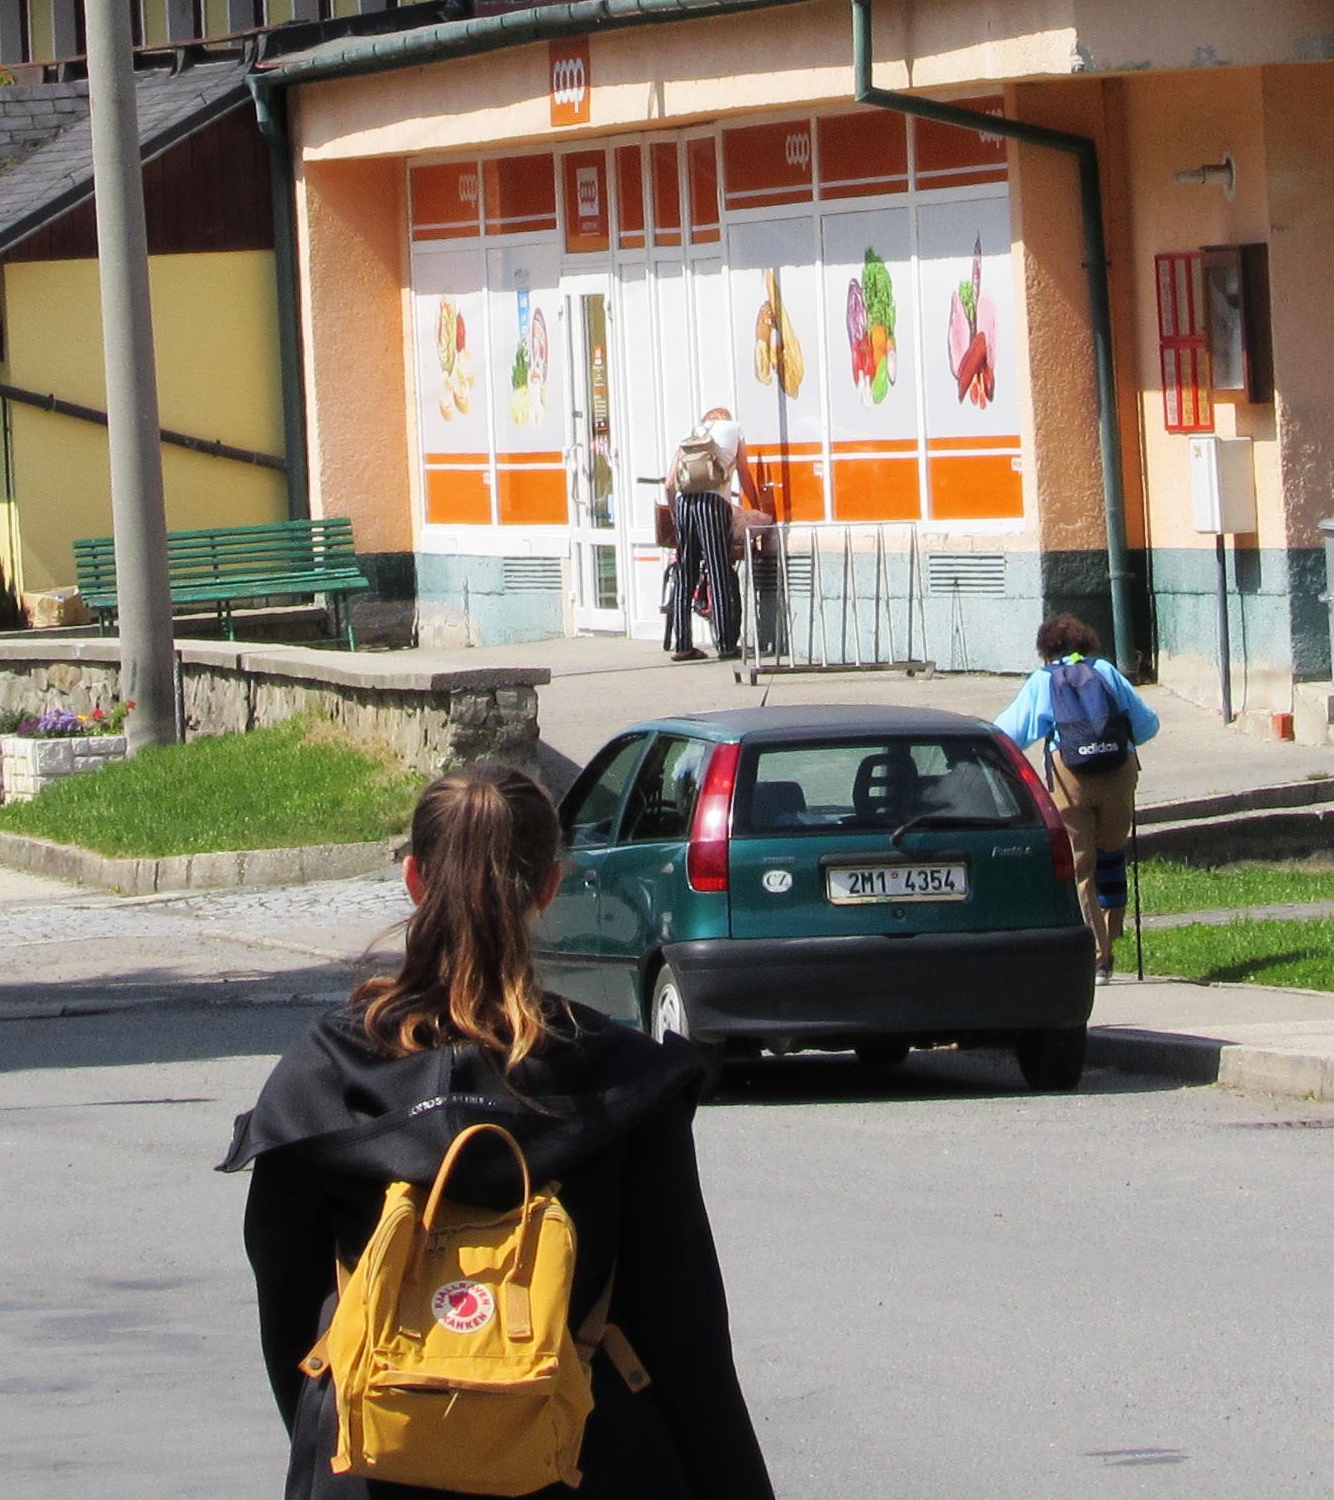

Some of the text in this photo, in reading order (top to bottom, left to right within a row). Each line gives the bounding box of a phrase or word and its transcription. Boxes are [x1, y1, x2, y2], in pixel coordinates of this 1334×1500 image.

[1078, 742, 1119, 756] adidas
[766, 874, 789, 888] CZ
[848, 868, 956, 895] 2M1 4354
